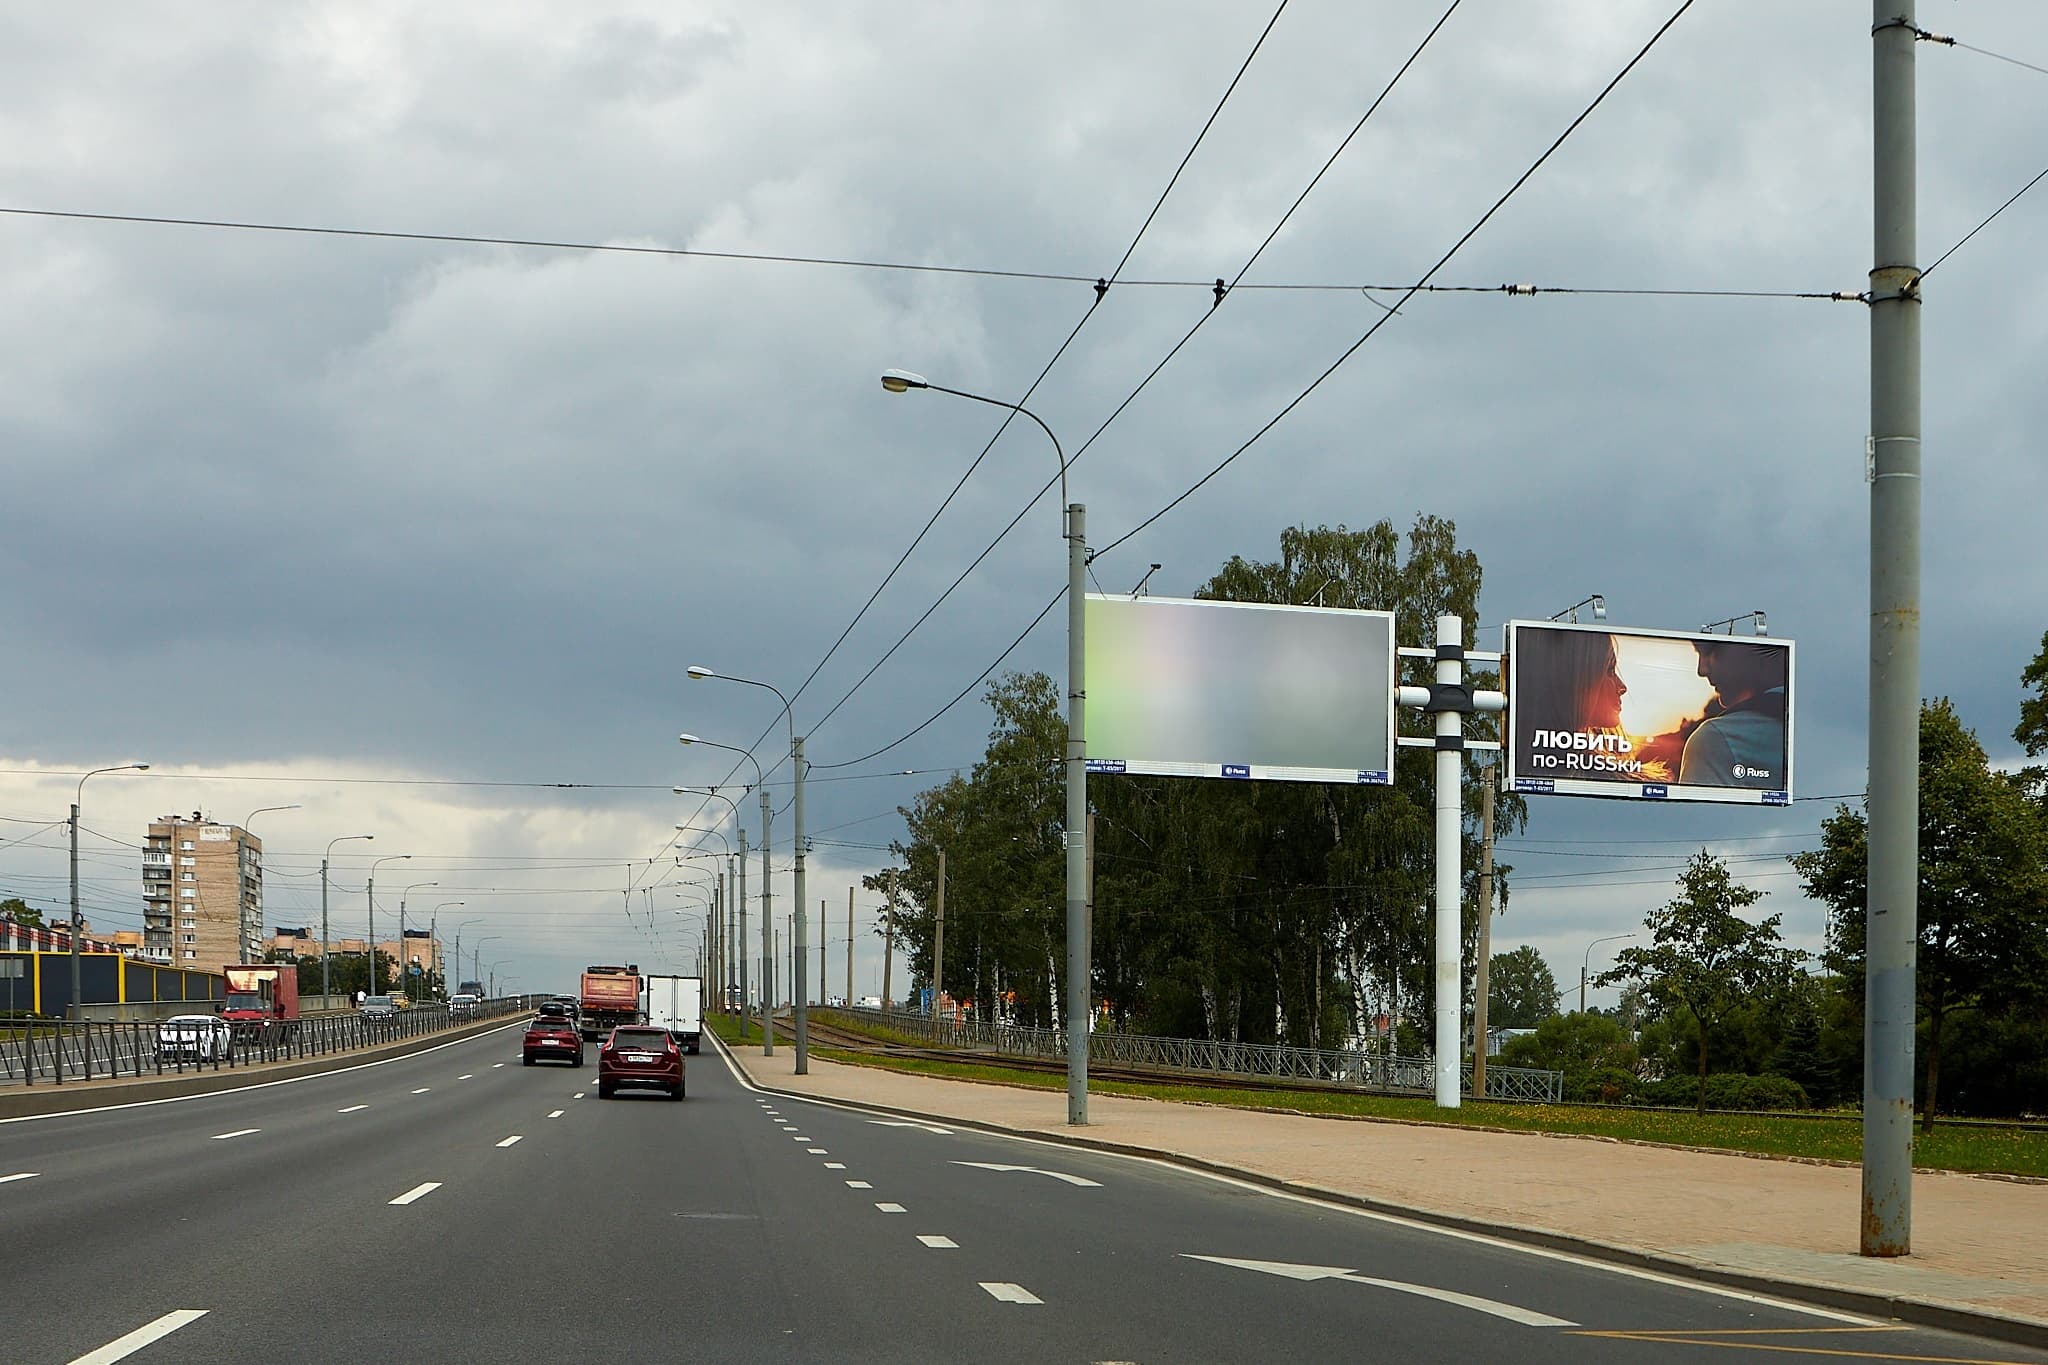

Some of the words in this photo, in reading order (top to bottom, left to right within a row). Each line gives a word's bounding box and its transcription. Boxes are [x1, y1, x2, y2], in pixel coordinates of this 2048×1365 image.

[1532, 729, 1633, 753] ЛЮБИТЬ
[1532, 753, 1642, 773] по-RUSSки
[1746, 767, 1770, 779] Russ
[1652, 787, 1665, 795] Russ
